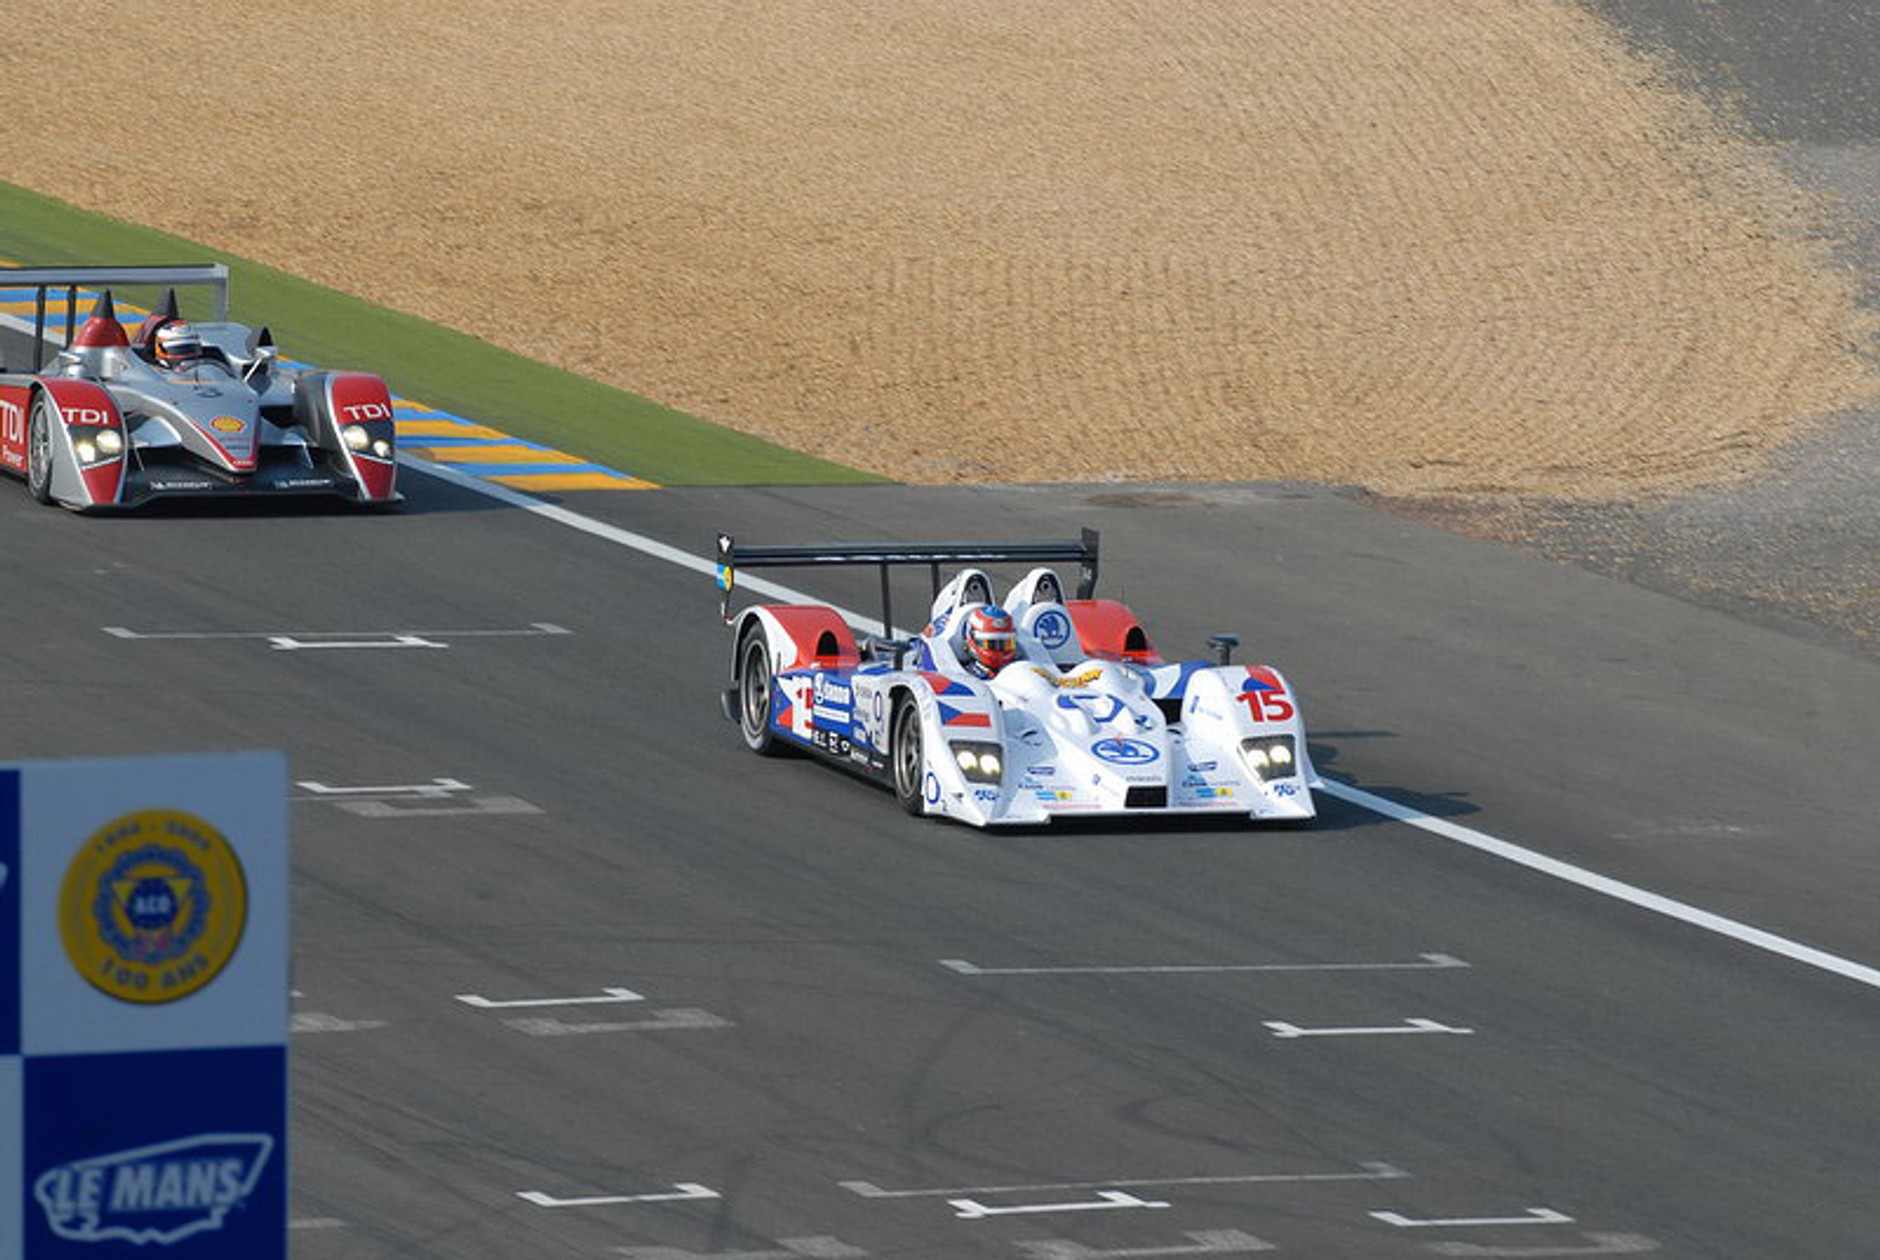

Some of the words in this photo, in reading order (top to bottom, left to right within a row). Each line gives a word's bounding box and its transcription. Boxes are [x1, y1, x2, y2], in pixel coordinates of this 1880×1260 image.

[62, 406, 109, 424] TDI
[343, 404, 392, 420] TDI
[1235, 689, 1294, 723] 15
[135, 896, 171, 915] ACO
[102, 957, 150, 990] 100
[161, 953, 209, 988] ANS
[54, 1167, 103, 1211] LE
[109, 1158, 243, 1211] MANS
